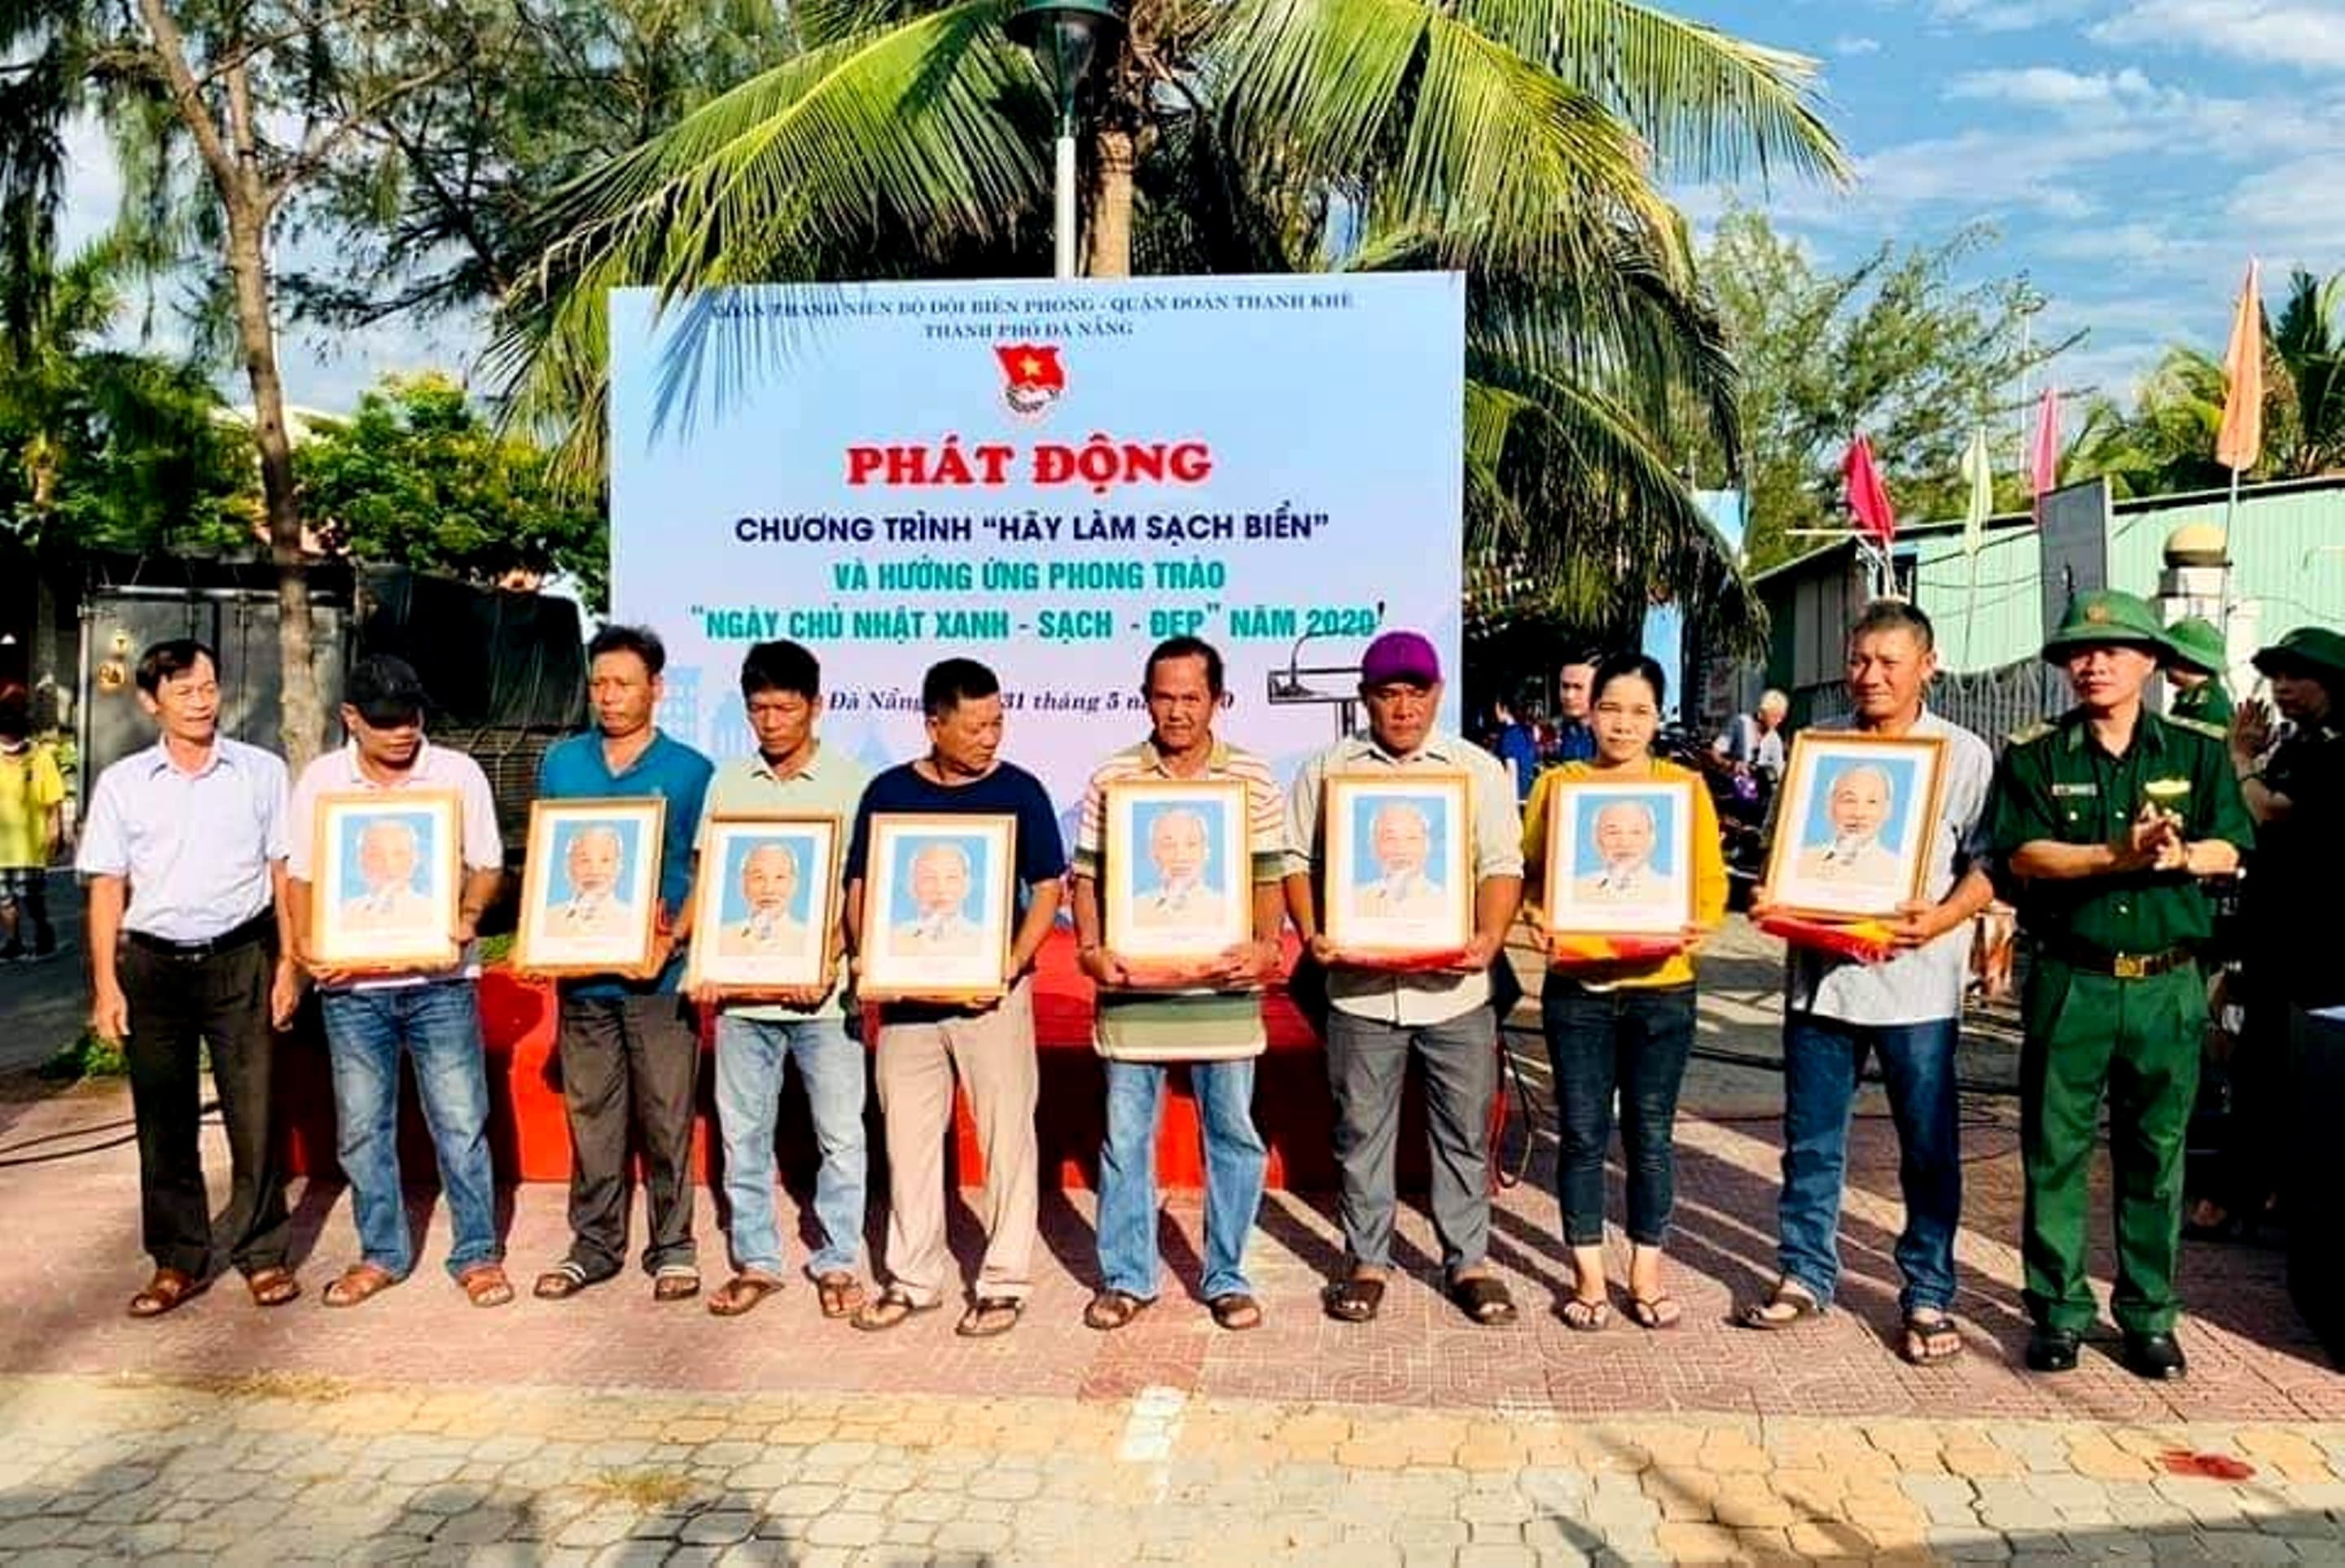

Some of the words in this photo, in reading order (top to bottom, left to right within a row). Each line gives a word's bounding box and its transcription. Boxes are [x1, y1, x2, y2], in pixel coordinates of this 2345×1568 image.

[846, 435, 1015, 485] PHÁT
[1032, 433, 1212, 494] ĐỘNG
[735, 513, 874, 542] CHƯƠNG
[883, 510, 972, 541] TRÌNH
[982, 510, 1062, 541] “HÃY
[1072, 509, 1137, 540] LÀM
[1146, 513, 1233, 547] SẠCH
[1244, 500, 1329, 539] BIỂN”
[834, 558, 870, 590] VÀ
[983, 555, 1040, 590] ỨNG
[1049, 561, 1143, 590] PHONG
[1154, 555, 1226, 589] TRÀO
[788, 602, 844, 638] CHỦ
[853, 605, 926, 644] NHẬT
[936, 611, 1008, 638] XANH
[1038, 610, 1113, 644] SẠCH
[1230, 604, 1295, 637] NĂM
[1306, 609, 1377, 637] 2020
[829, 690, 860, 711] Đà
[1033, 690, 1100, 713] tháng
[1106, 690, 1120, 710] 5
